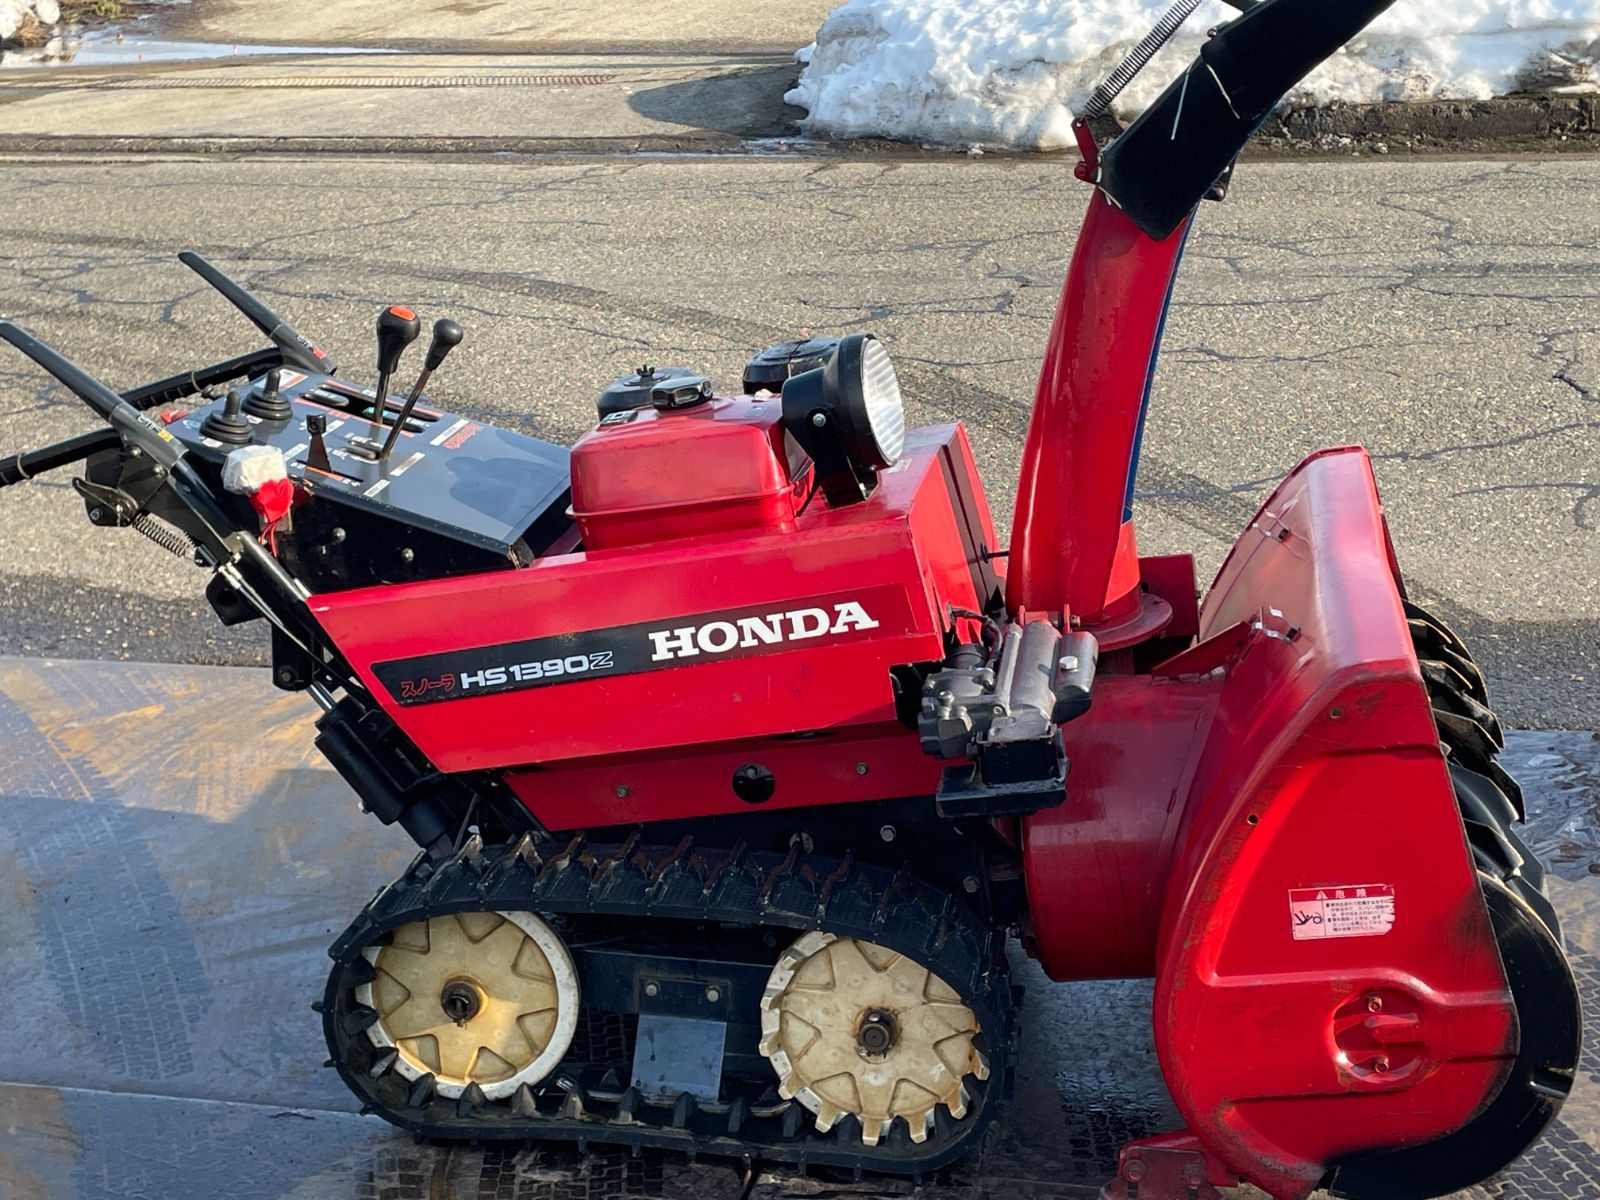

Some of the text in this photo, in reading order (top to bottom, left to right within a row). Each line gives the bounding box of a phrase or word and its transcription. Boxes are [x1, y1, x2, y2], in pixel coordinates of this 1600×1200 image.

[648, 601, 880, 662] HONDA
[401, 651, 614, 698] スノーラ HS1390Z
